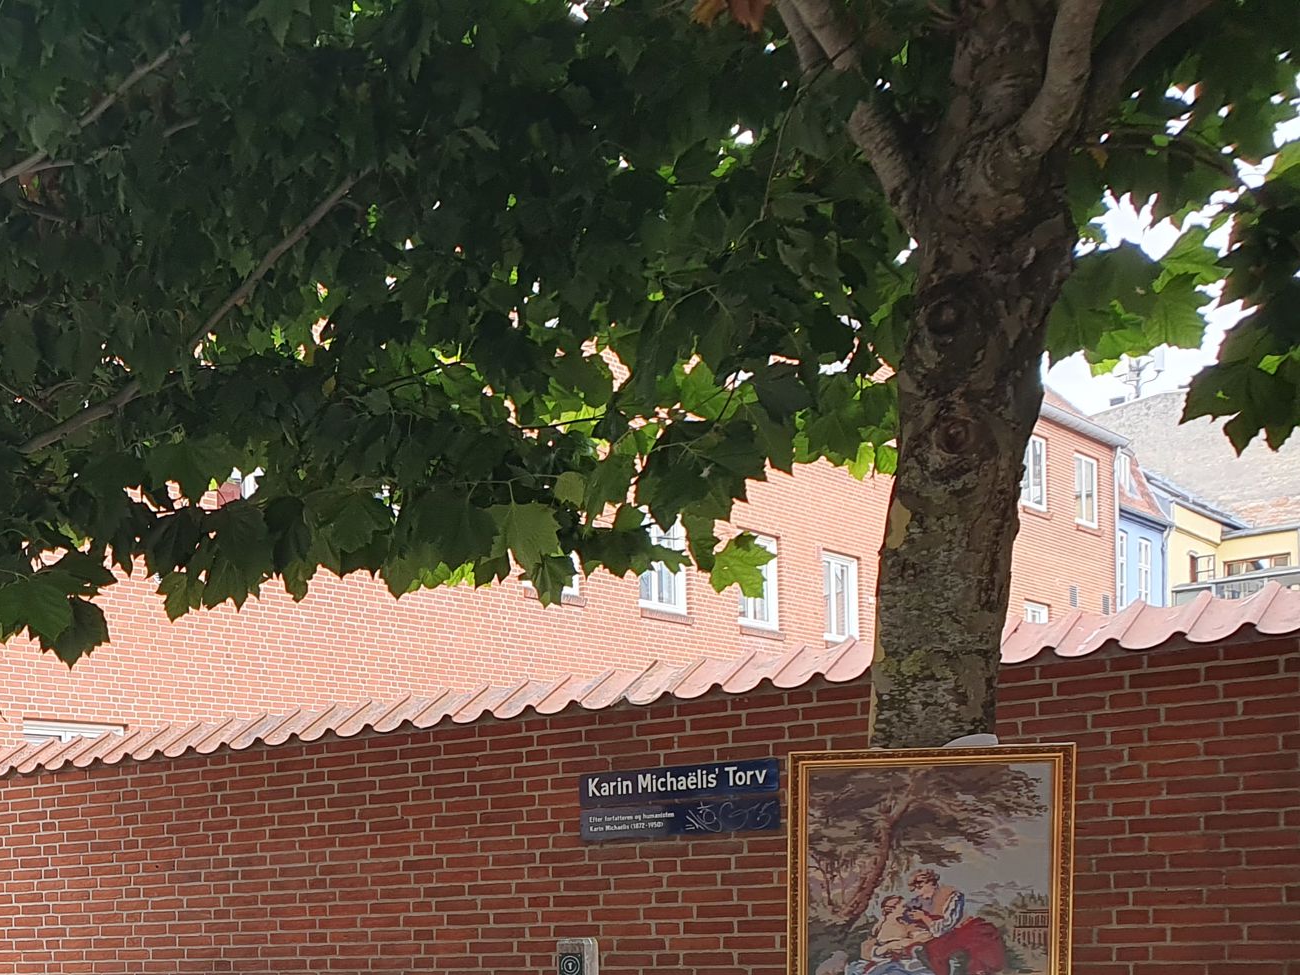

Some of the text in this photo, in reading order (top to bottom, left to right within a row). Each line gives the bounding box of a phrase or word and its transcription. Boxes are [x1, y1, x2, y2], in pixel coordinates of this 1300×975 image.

[587, 777, 633, 798] Karin
[724, 766, 768, 787] Torv
[604, 814, 634, 822] forfatteren
[642, 811, 675, 819] humanisten
